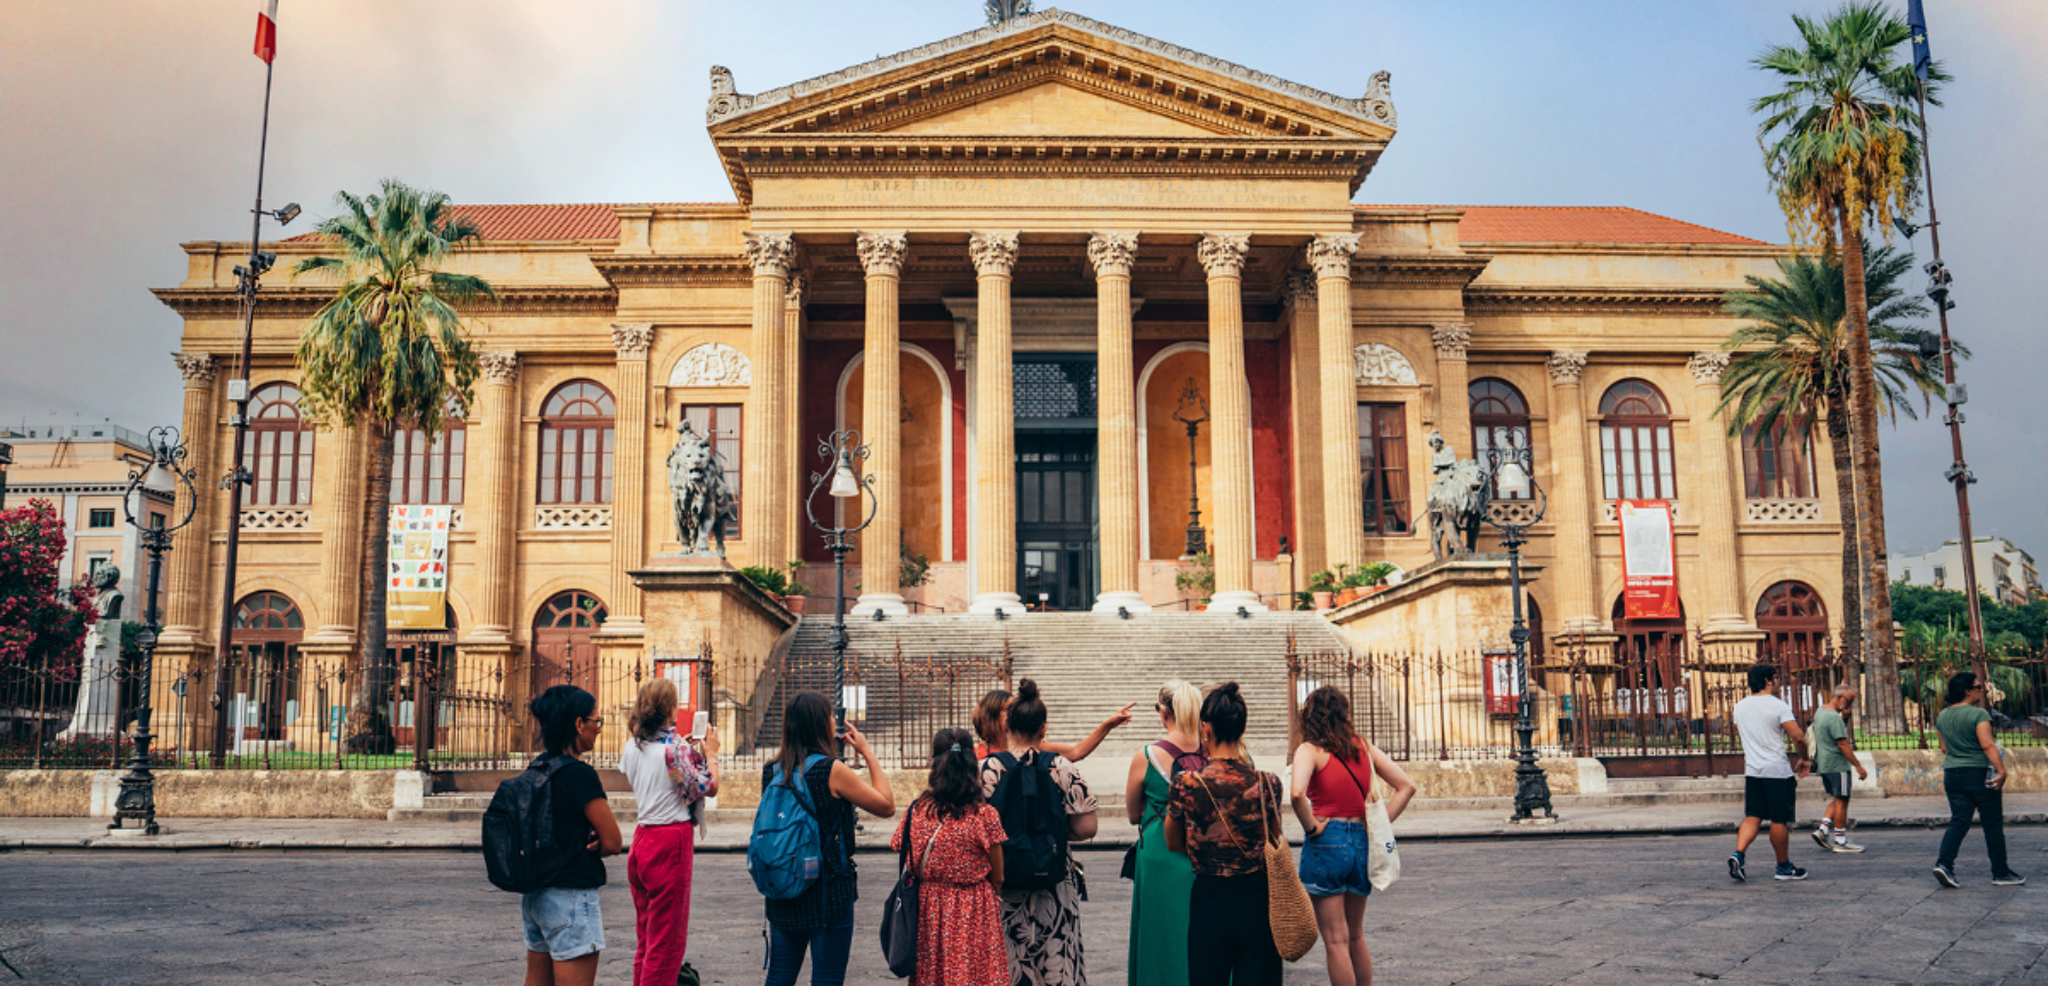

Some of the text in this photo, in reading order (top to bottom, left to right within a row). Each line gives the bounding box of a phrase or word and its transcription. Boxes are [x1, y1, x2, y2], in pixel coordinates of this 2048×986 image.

[845, 180, 902, 191] L'ARTE
[911, 180, 987, 191] RINNOVA
[1011, 180, 1068, 191] POPOLI
[1127, 181, 1186, 192] RIVELA
[1197, 182, 1213, 193] LA
[1224, 182, 1261, 193] VITA
